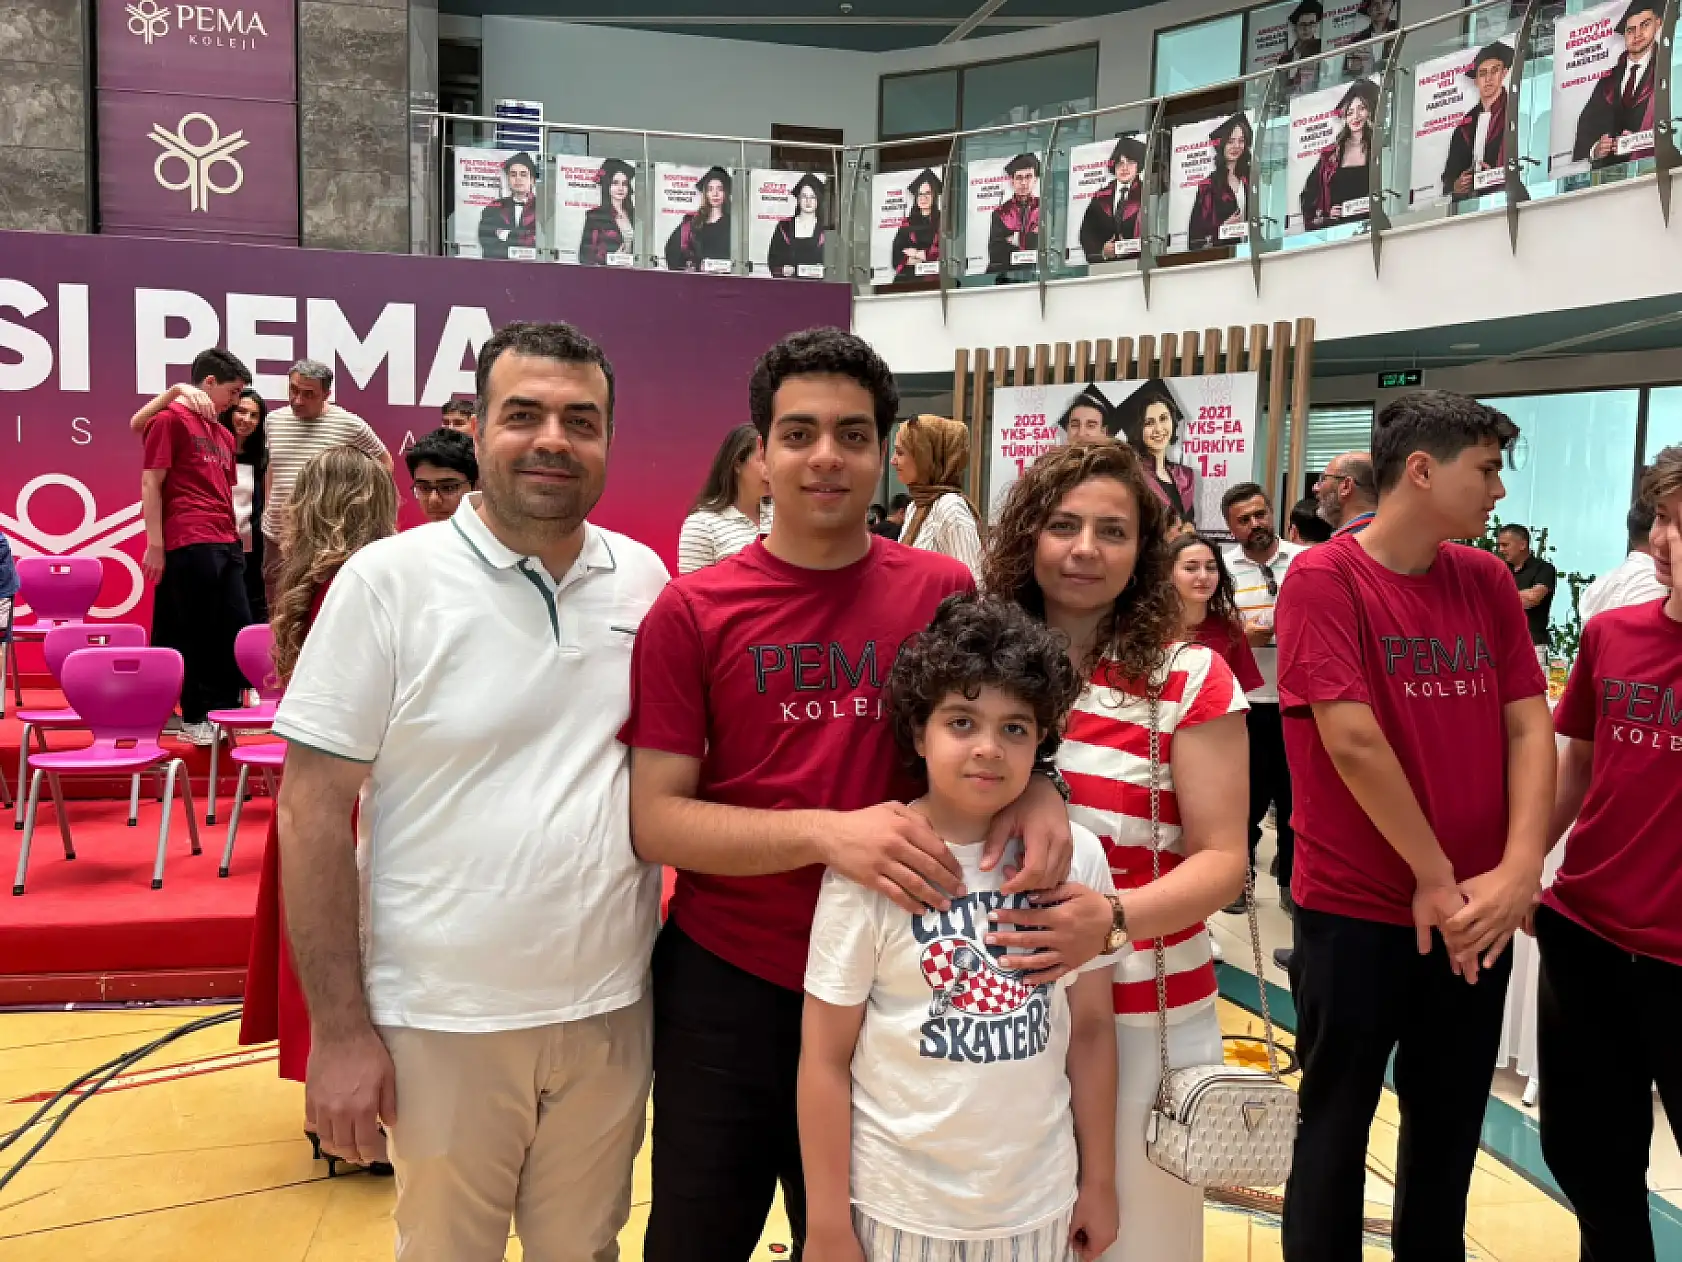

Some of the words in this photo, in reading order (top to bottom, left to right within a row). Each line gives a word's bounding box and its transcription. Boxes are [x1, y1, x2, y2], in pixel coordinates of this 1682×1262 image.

[175, 4, 268, 37] PEMA
[135, 286, 494, 407] PEMA
[1014, 413, 1046, 427] 2023
[1198, 405, 1232, 420] 2021
[1001, 426, 1058, 440] YKS-SAY
[1187, 420, 1243, 435] YKS-EA
[1001, 441, 1049, 458] TÜRKİY
[1183, 436, 1245, 454] TÜRKİYE
[1381, 633, 1496, 675] PEMA
[748, 640, 881, 694] PEM
[780, 697, 882, 722] KOLEJ
[1602, 678, 1682, 726] PEM
[1612, 725, 1682, 751] KOLE
